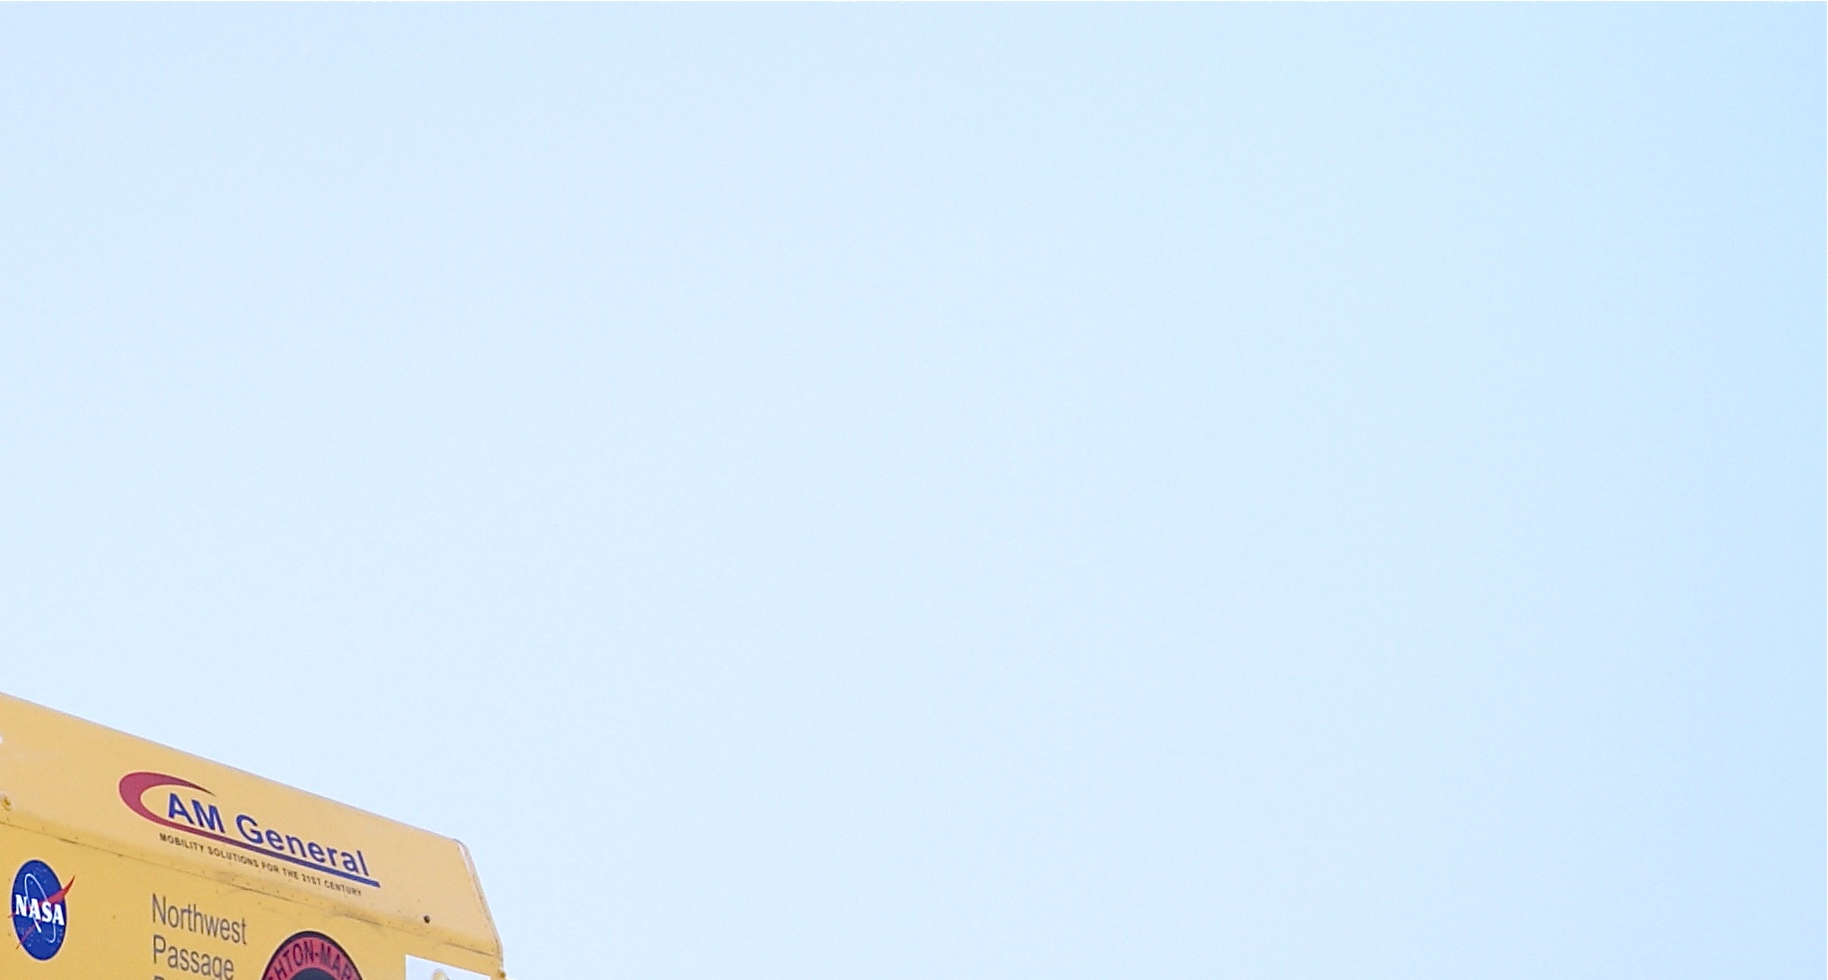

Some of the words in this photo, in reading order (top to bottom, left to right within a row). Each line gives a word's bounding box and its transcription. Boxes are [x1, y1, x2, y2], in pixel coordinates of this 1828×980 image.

[167, 792, 225, 834] AM
[235, 814, 369, 876] General
[159, 833, 204, 852] MOBILITY
[207, 845, 259, 868] SOLUTIONS
[262, 860, 279, 874] FOR
[282, 867, 299, 880] THE
[301, 873, 321, 886] 21ST
[324, 879, 362, 897] CENTURY
[15, 894, 65, 926] NASA
[152, 893, 248, 946] Northwest
